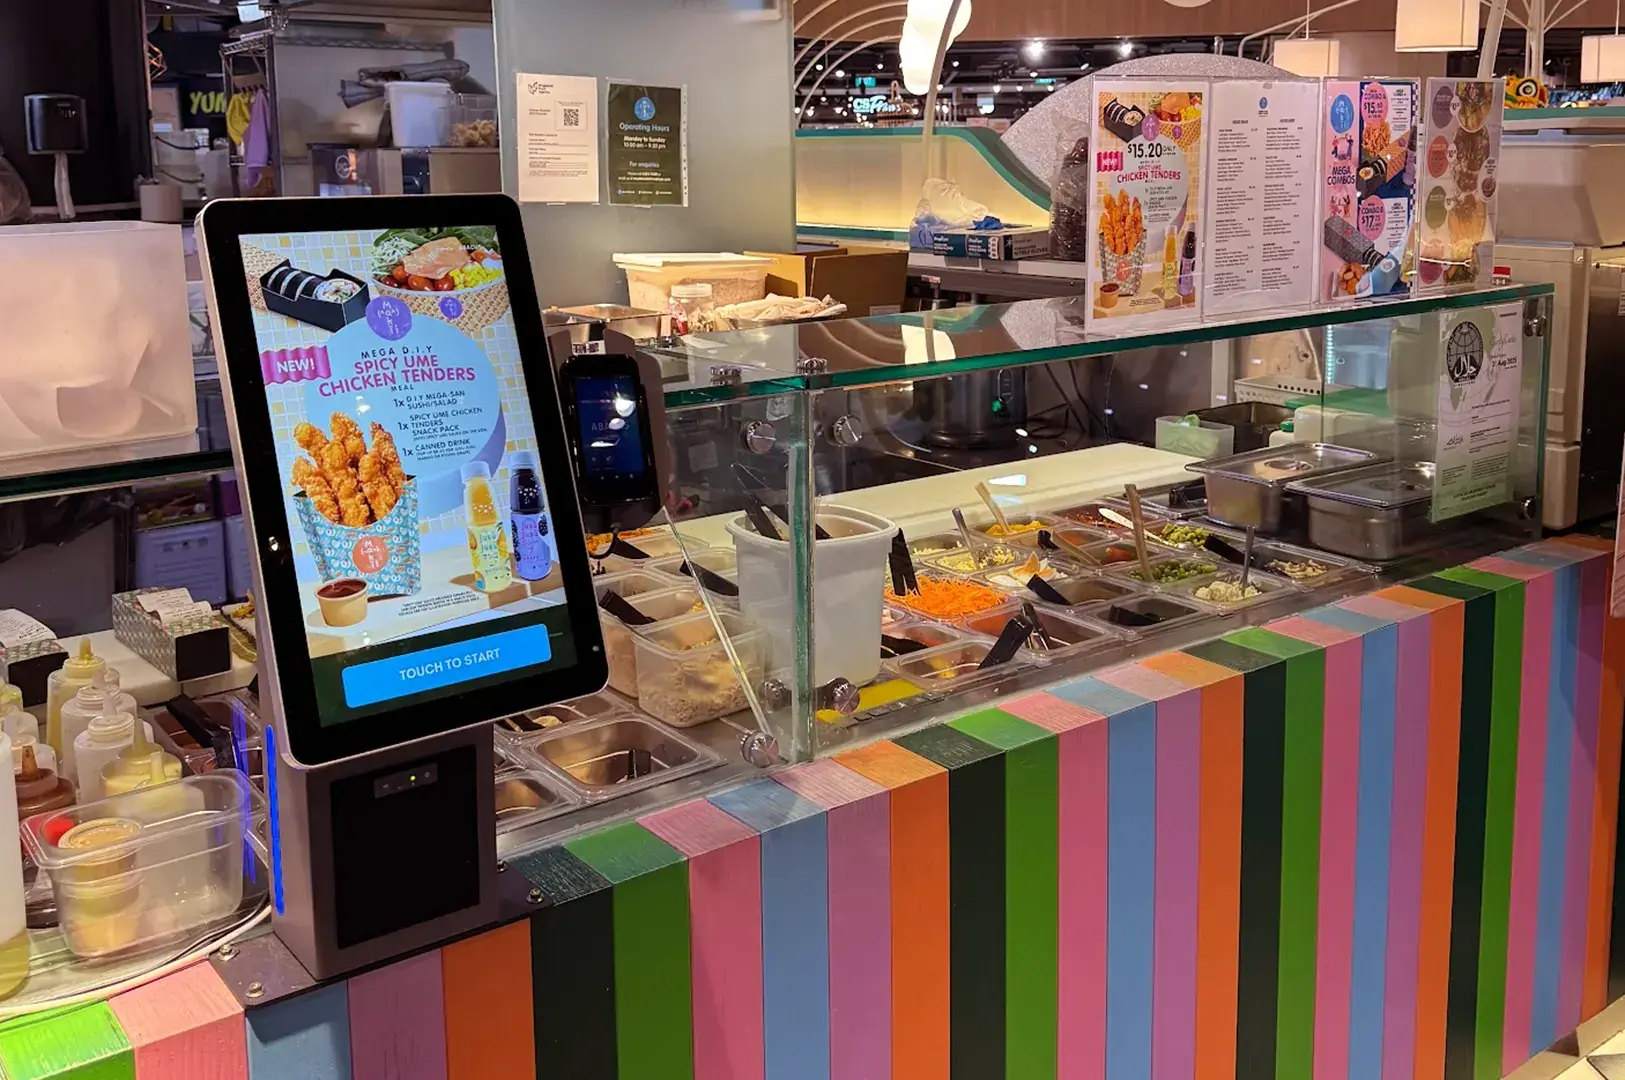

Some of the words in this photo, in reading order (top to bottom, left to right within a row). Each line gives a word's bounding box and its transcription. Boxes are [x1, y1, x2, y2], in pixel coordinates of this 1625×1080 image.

[619, 122, 651, 132] Operating
[652, 124, 670, 132] Hours
[1127, 142, 1163, 158] $15.20
[1332, 166, 1351, 175] MEGA
[1117, 171, 1149, 183] CHICKEN
[1150, 171, 1181, 181] TENDERS
[1327, 175, 1356, 185] COMBOS
[361, 347, 396, 360] MEGA
[402, 345, 433, 355] D.I.Y
[276, 359, 316, 374] NEW!
[354, 356, 399, 376] SPICY
[404, 354, 439, 369] UME
[1498, 359, 1506, 367] Aug
[319, 370, 397, 397] CHICKEN
[401, 367, 476, 384] TENDERS
[390, 384, 414, 392] MEAL
[426, 389, 466, 400] MEGA-SAN
[393, 398, 405, 408] 1x
[407, 398, 458, 410] SUSHI/SALAD
[409, 412, 431, 421] SPICY
[432, 410, 450, 419] UME
[451, 407, 483, 417] CHICKEN
[398, 421, 409, 430] 1x
[411, 419, 444, 428] TENDERS
[412, 427, 438, 436] SNACK
[439, 424, 460, 433] PACK
[415, 440, 446, 452] CANNED
[448, 438, 471, 447] DRINK
[402, 447, 414, 457] 1x
[399, 662, 444, 681] TOUCH
[445, 658, 462, 671] TO
[464, 648, 500, 666] START
